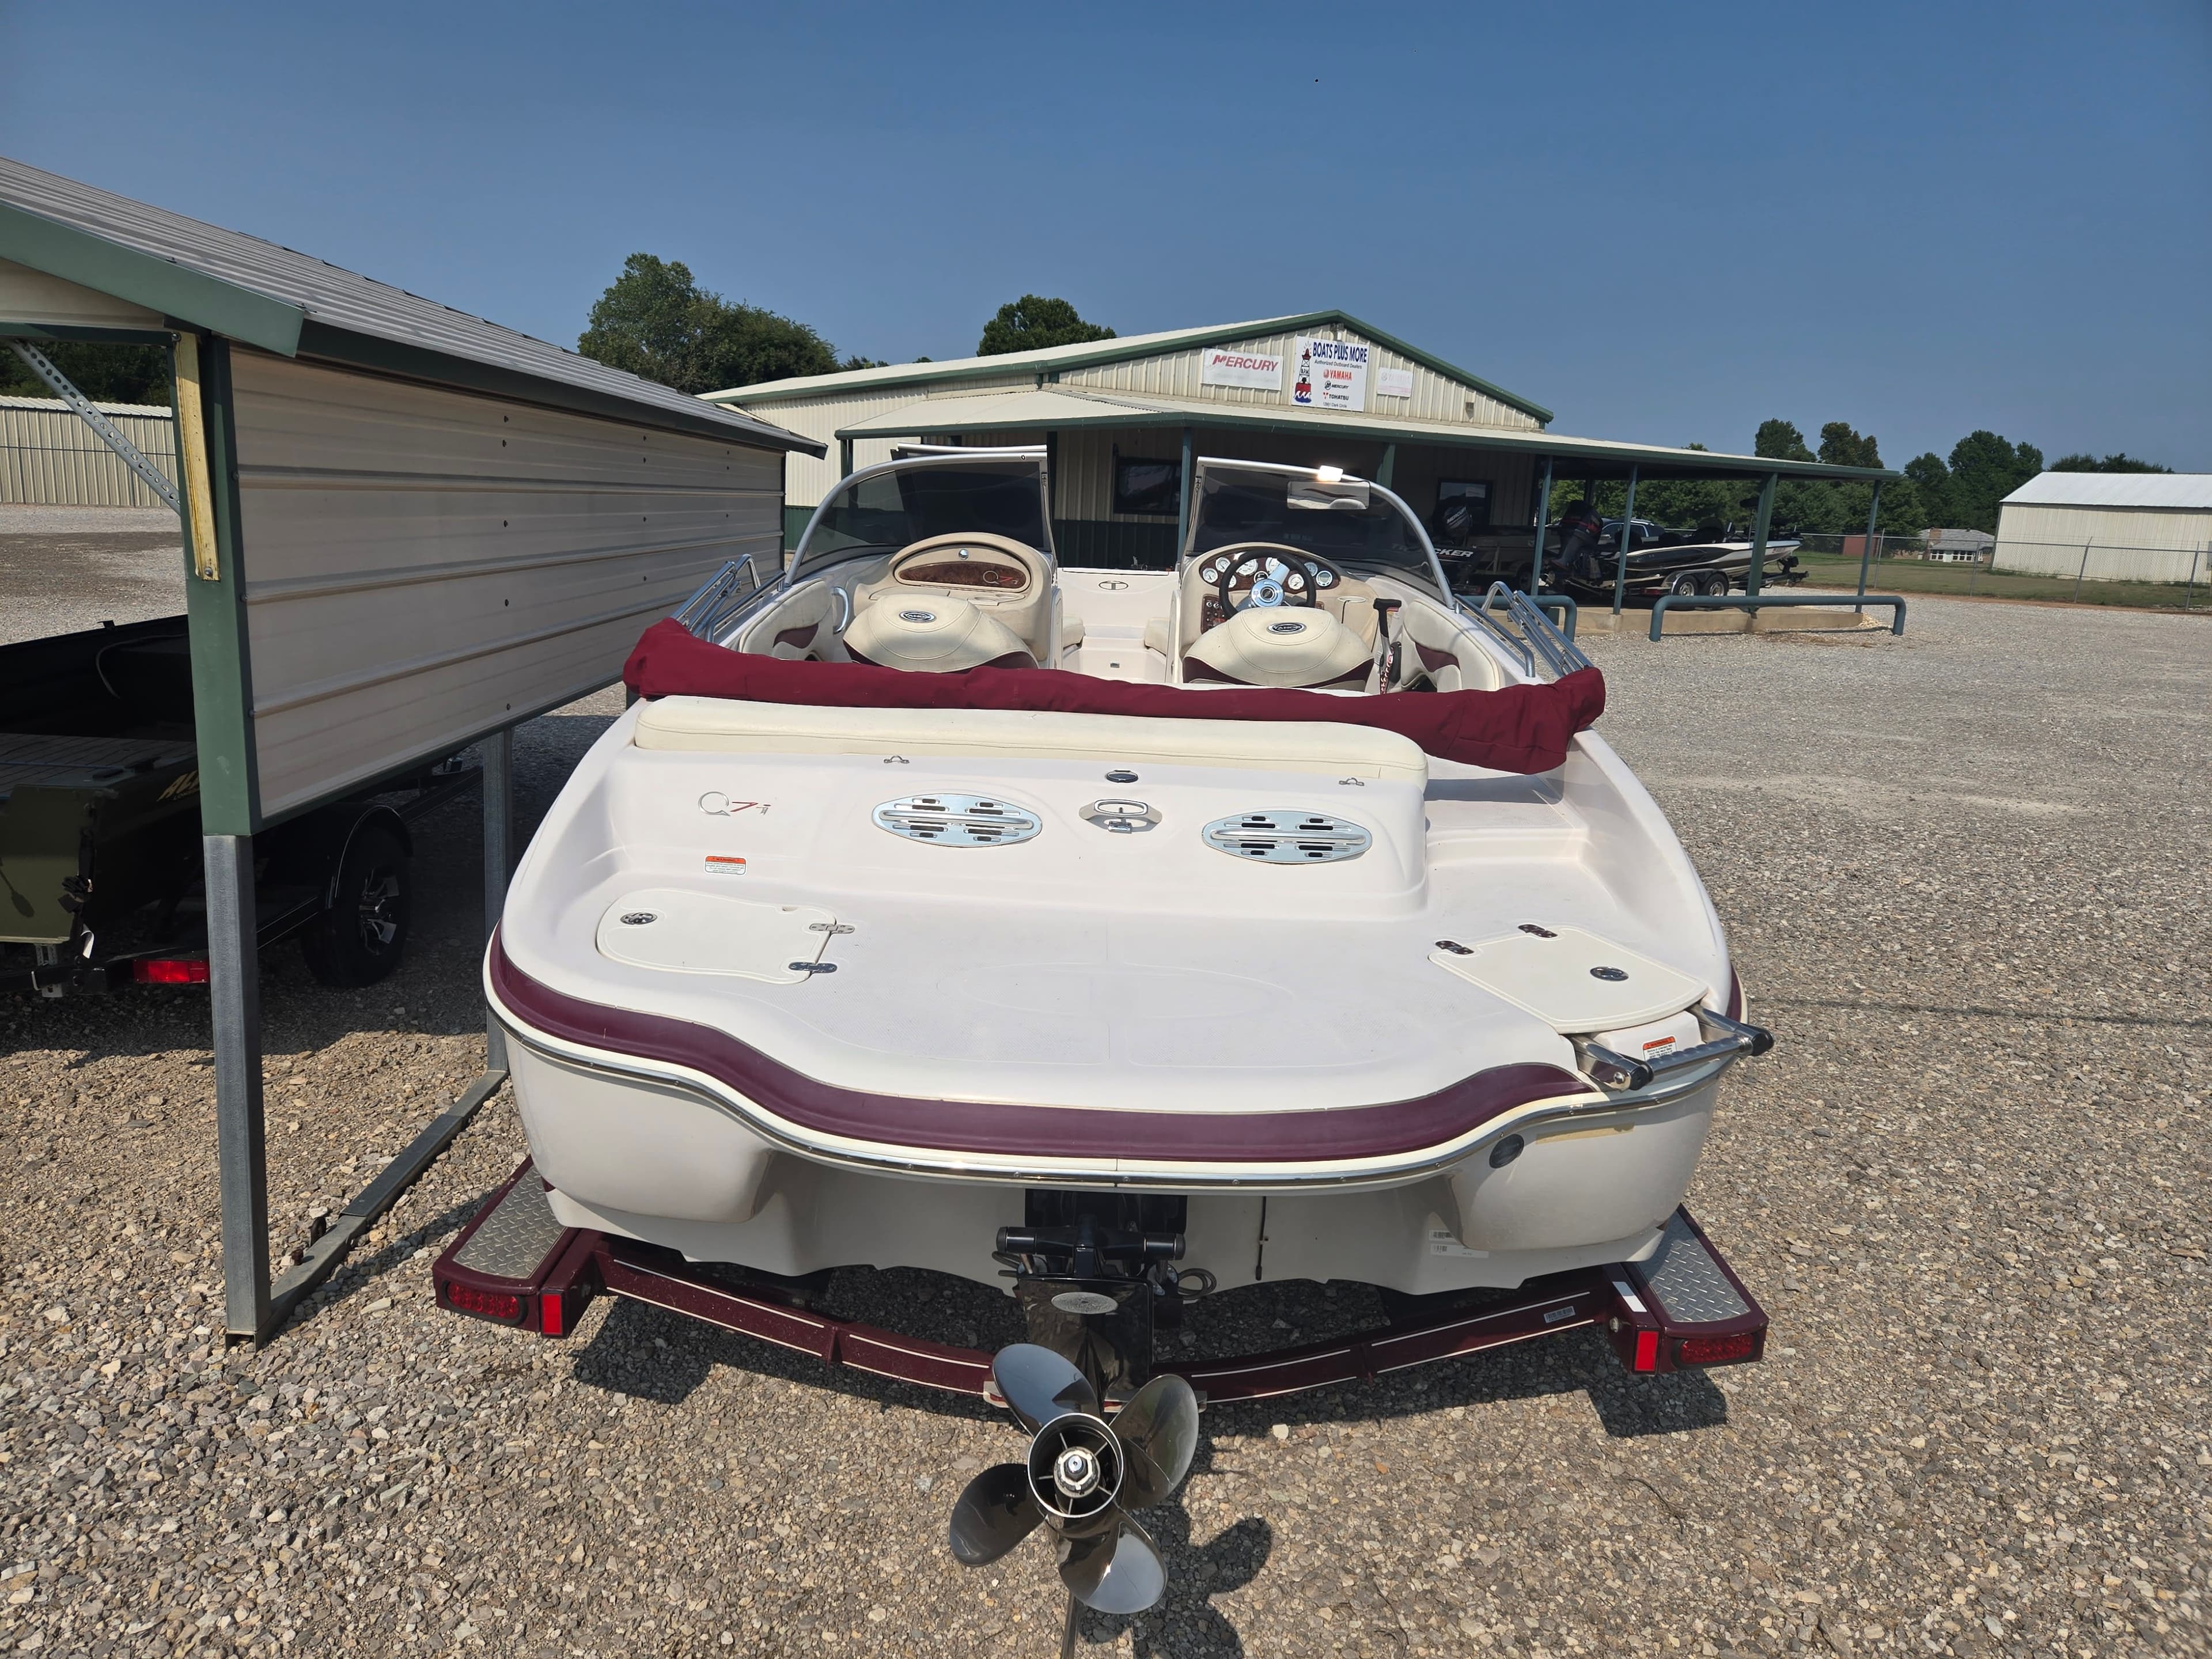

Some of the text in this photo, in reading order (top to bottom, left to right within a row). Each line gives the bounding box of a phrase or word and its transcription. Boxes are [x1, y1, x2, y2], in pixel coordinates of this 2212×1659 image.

[1313, 342, 1368, 363] BOATS PLUS MORE
[1212, 354, 1279, 372] MERCURY
[1330, 370, 1352, 381] YAMAHA
[1434, 548, 1474, 558] CKER
